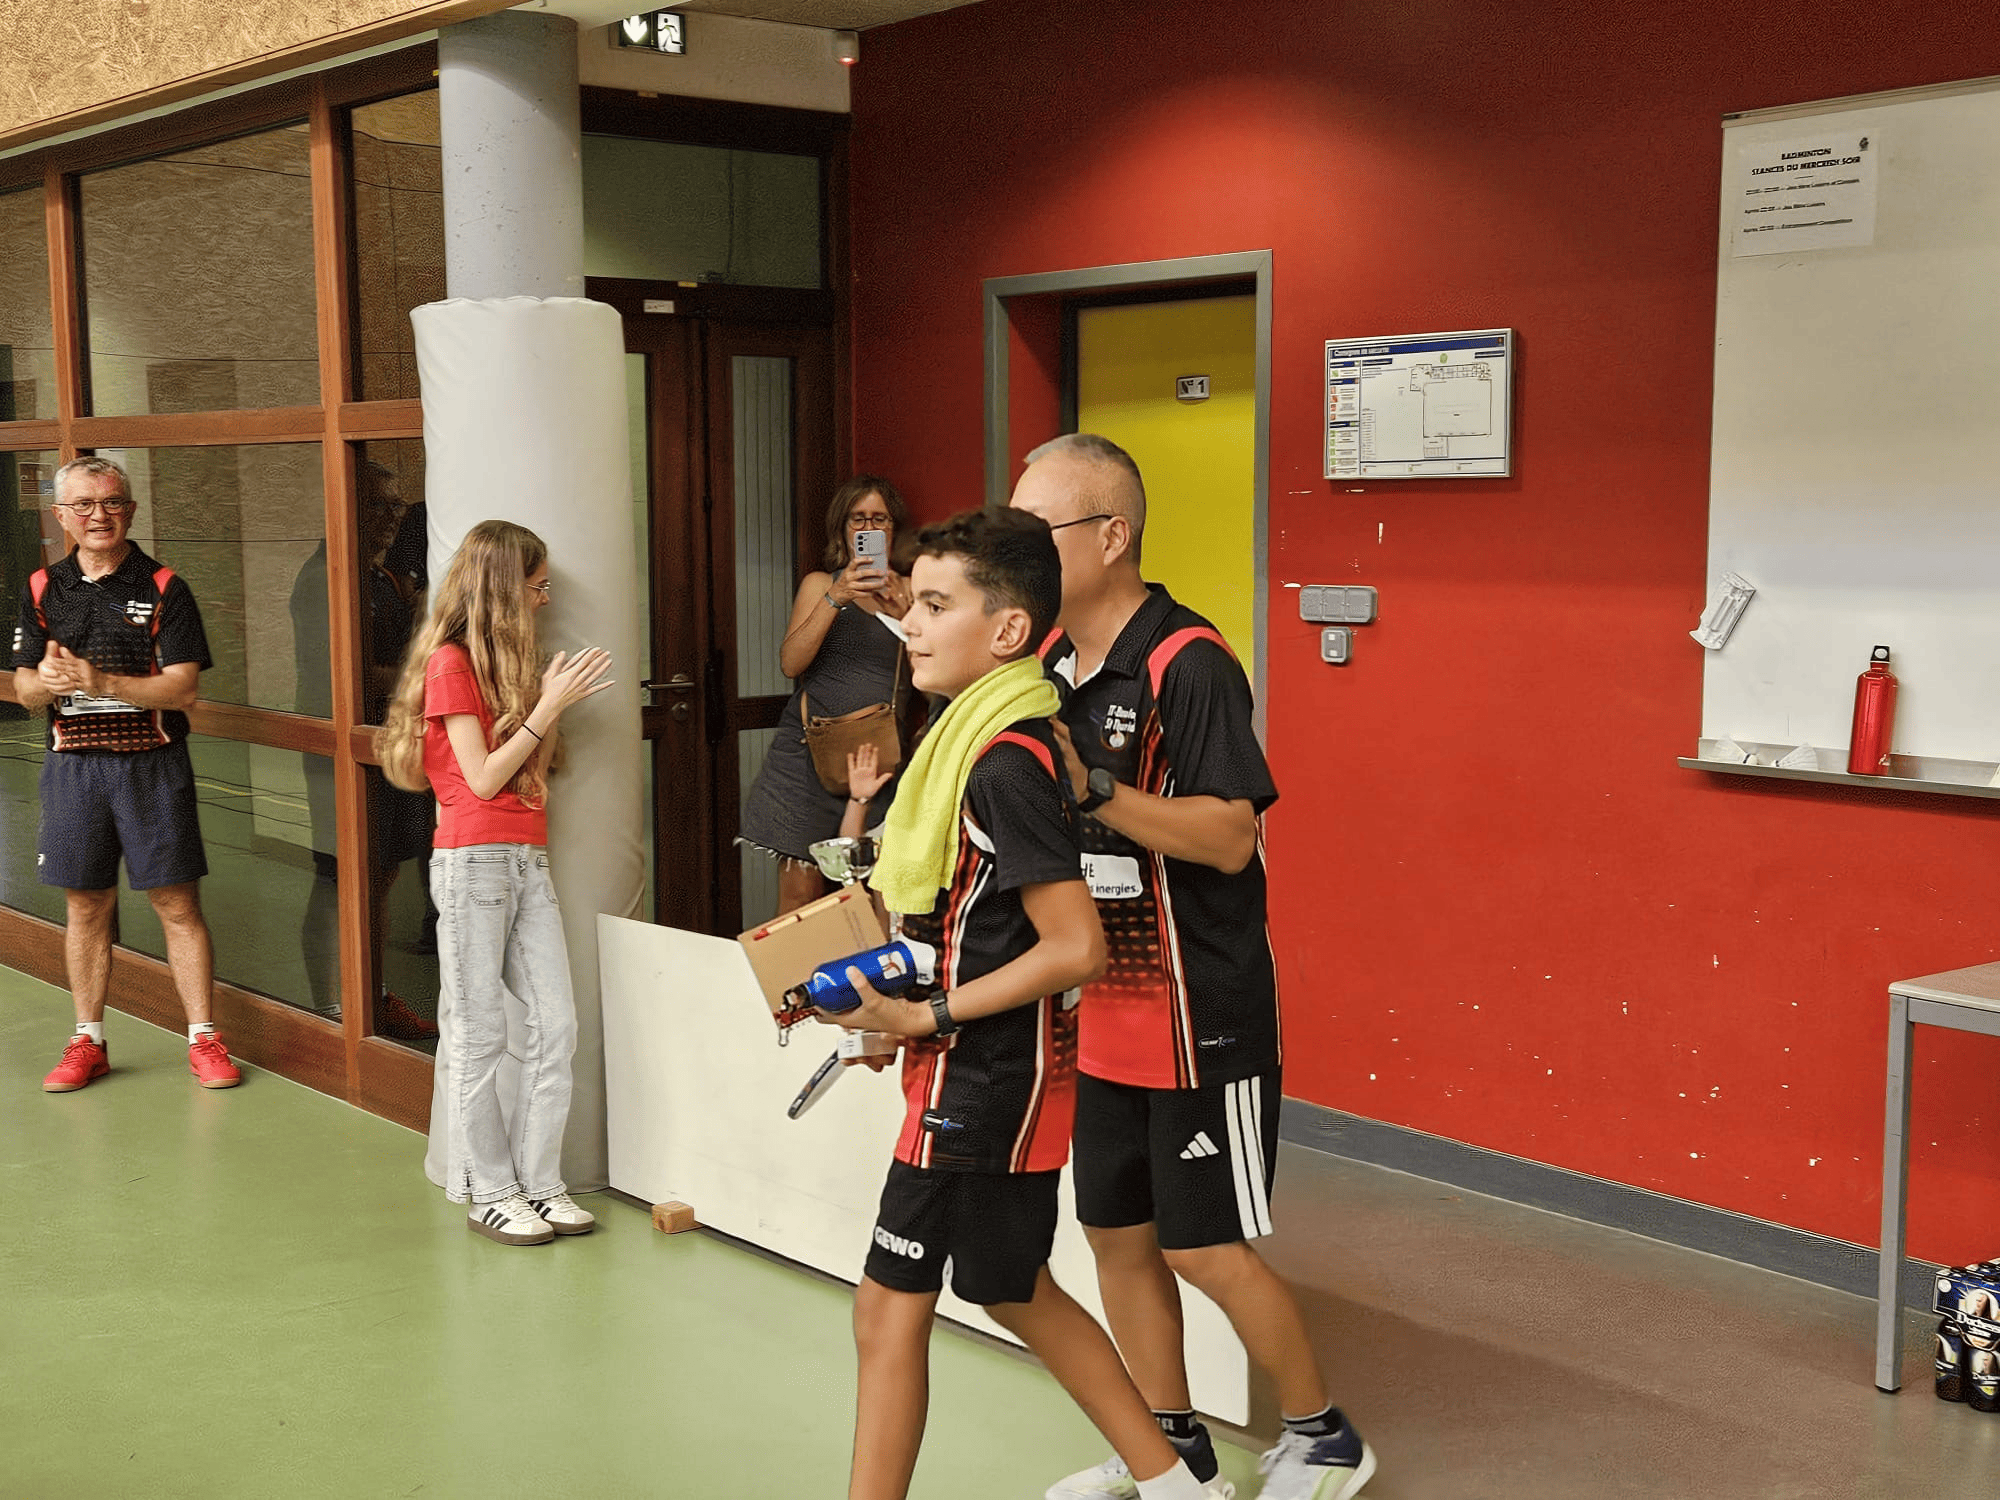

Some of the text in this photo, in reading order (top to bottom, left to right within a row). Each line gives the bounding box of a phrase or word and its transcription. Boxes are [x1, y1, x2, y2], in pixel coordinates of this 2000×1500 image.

[1781, 148, 1832, 160] BADMINTON
[1786, 163, 1798, 172] DU
[1842, 156, 1861, 165] SOIR
